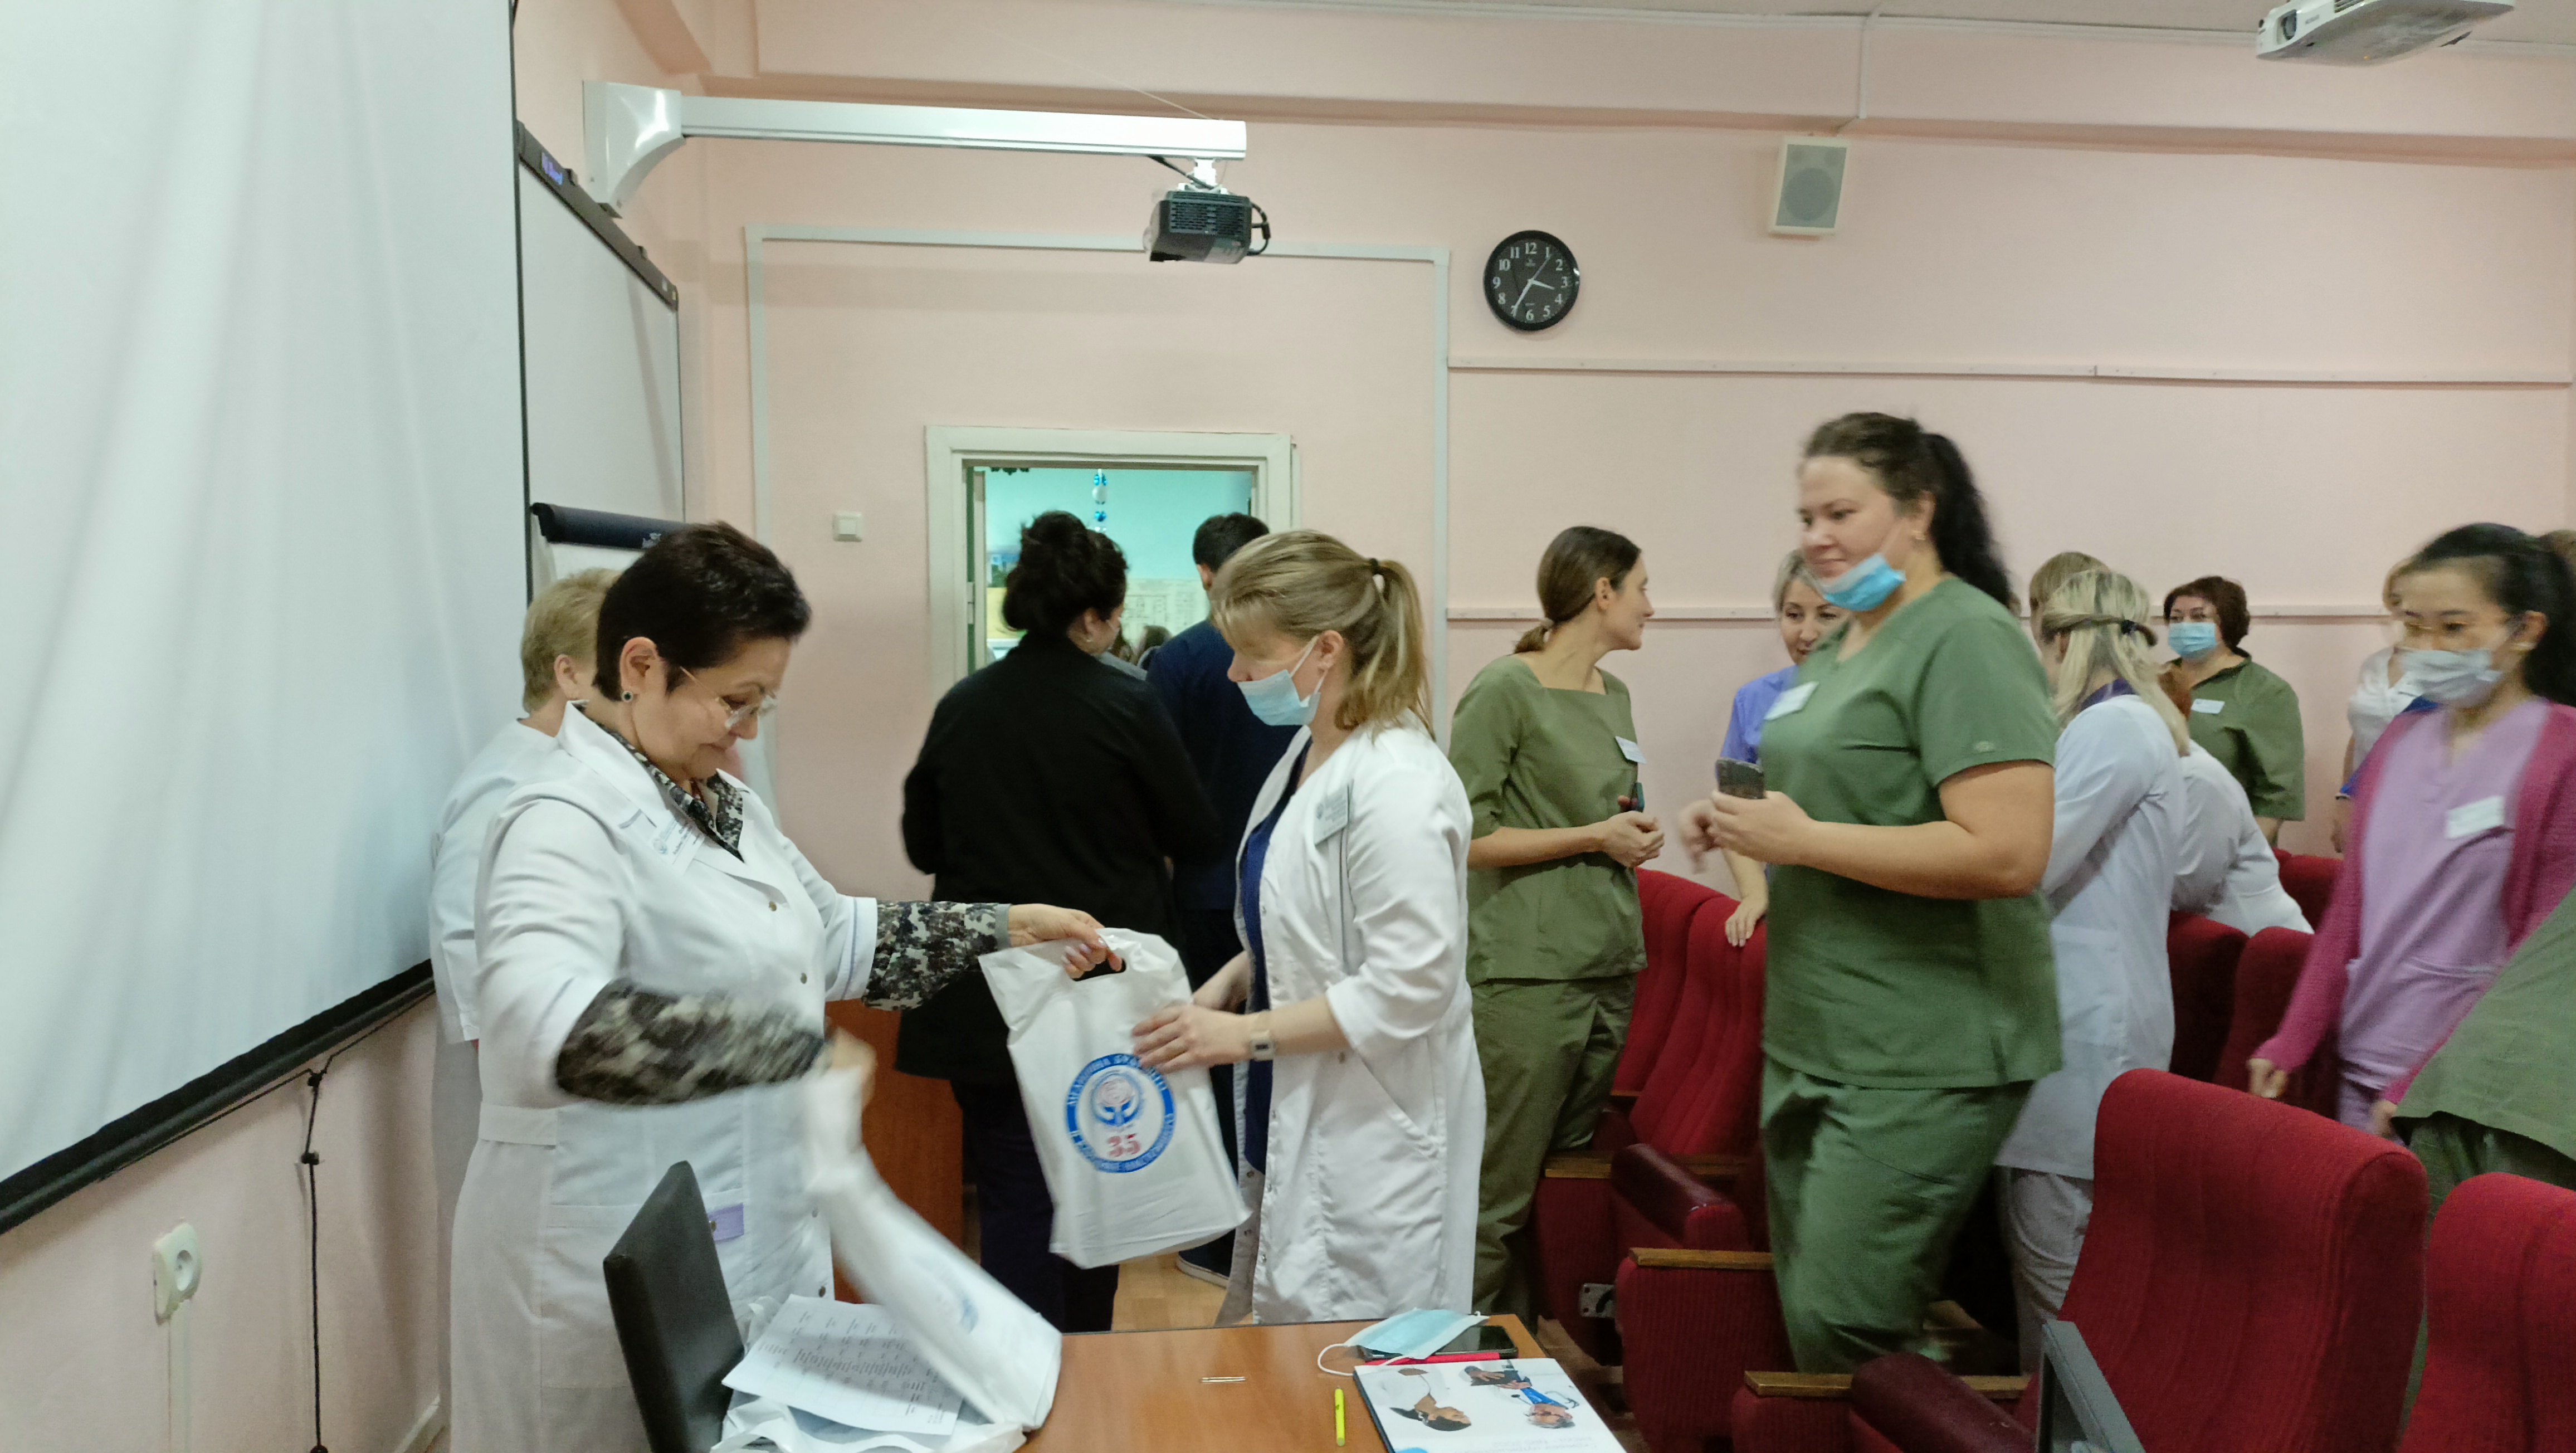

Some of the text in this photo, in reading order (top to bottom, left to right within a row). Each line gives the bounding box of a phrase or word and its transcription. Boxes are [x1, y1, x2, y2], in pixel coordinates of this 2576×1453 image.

[1510, 246, 1520, 259] 11
[1525, 242, 1538, 255] 12
[1545, 246, 1550, 258] 1
[1499, 259, 1511, 271] 10
[1555, 259, 1563, 271] 2
[1492, 276, 1501, 289] 9
[1561, 276, 1568, 288] 3
[1497, 292, 1506, 304] 8
[1554, 294, 1563, 304] 4
[1526, 309, 1534, 321] 6
[1543, 305, 1551, 318] 5
